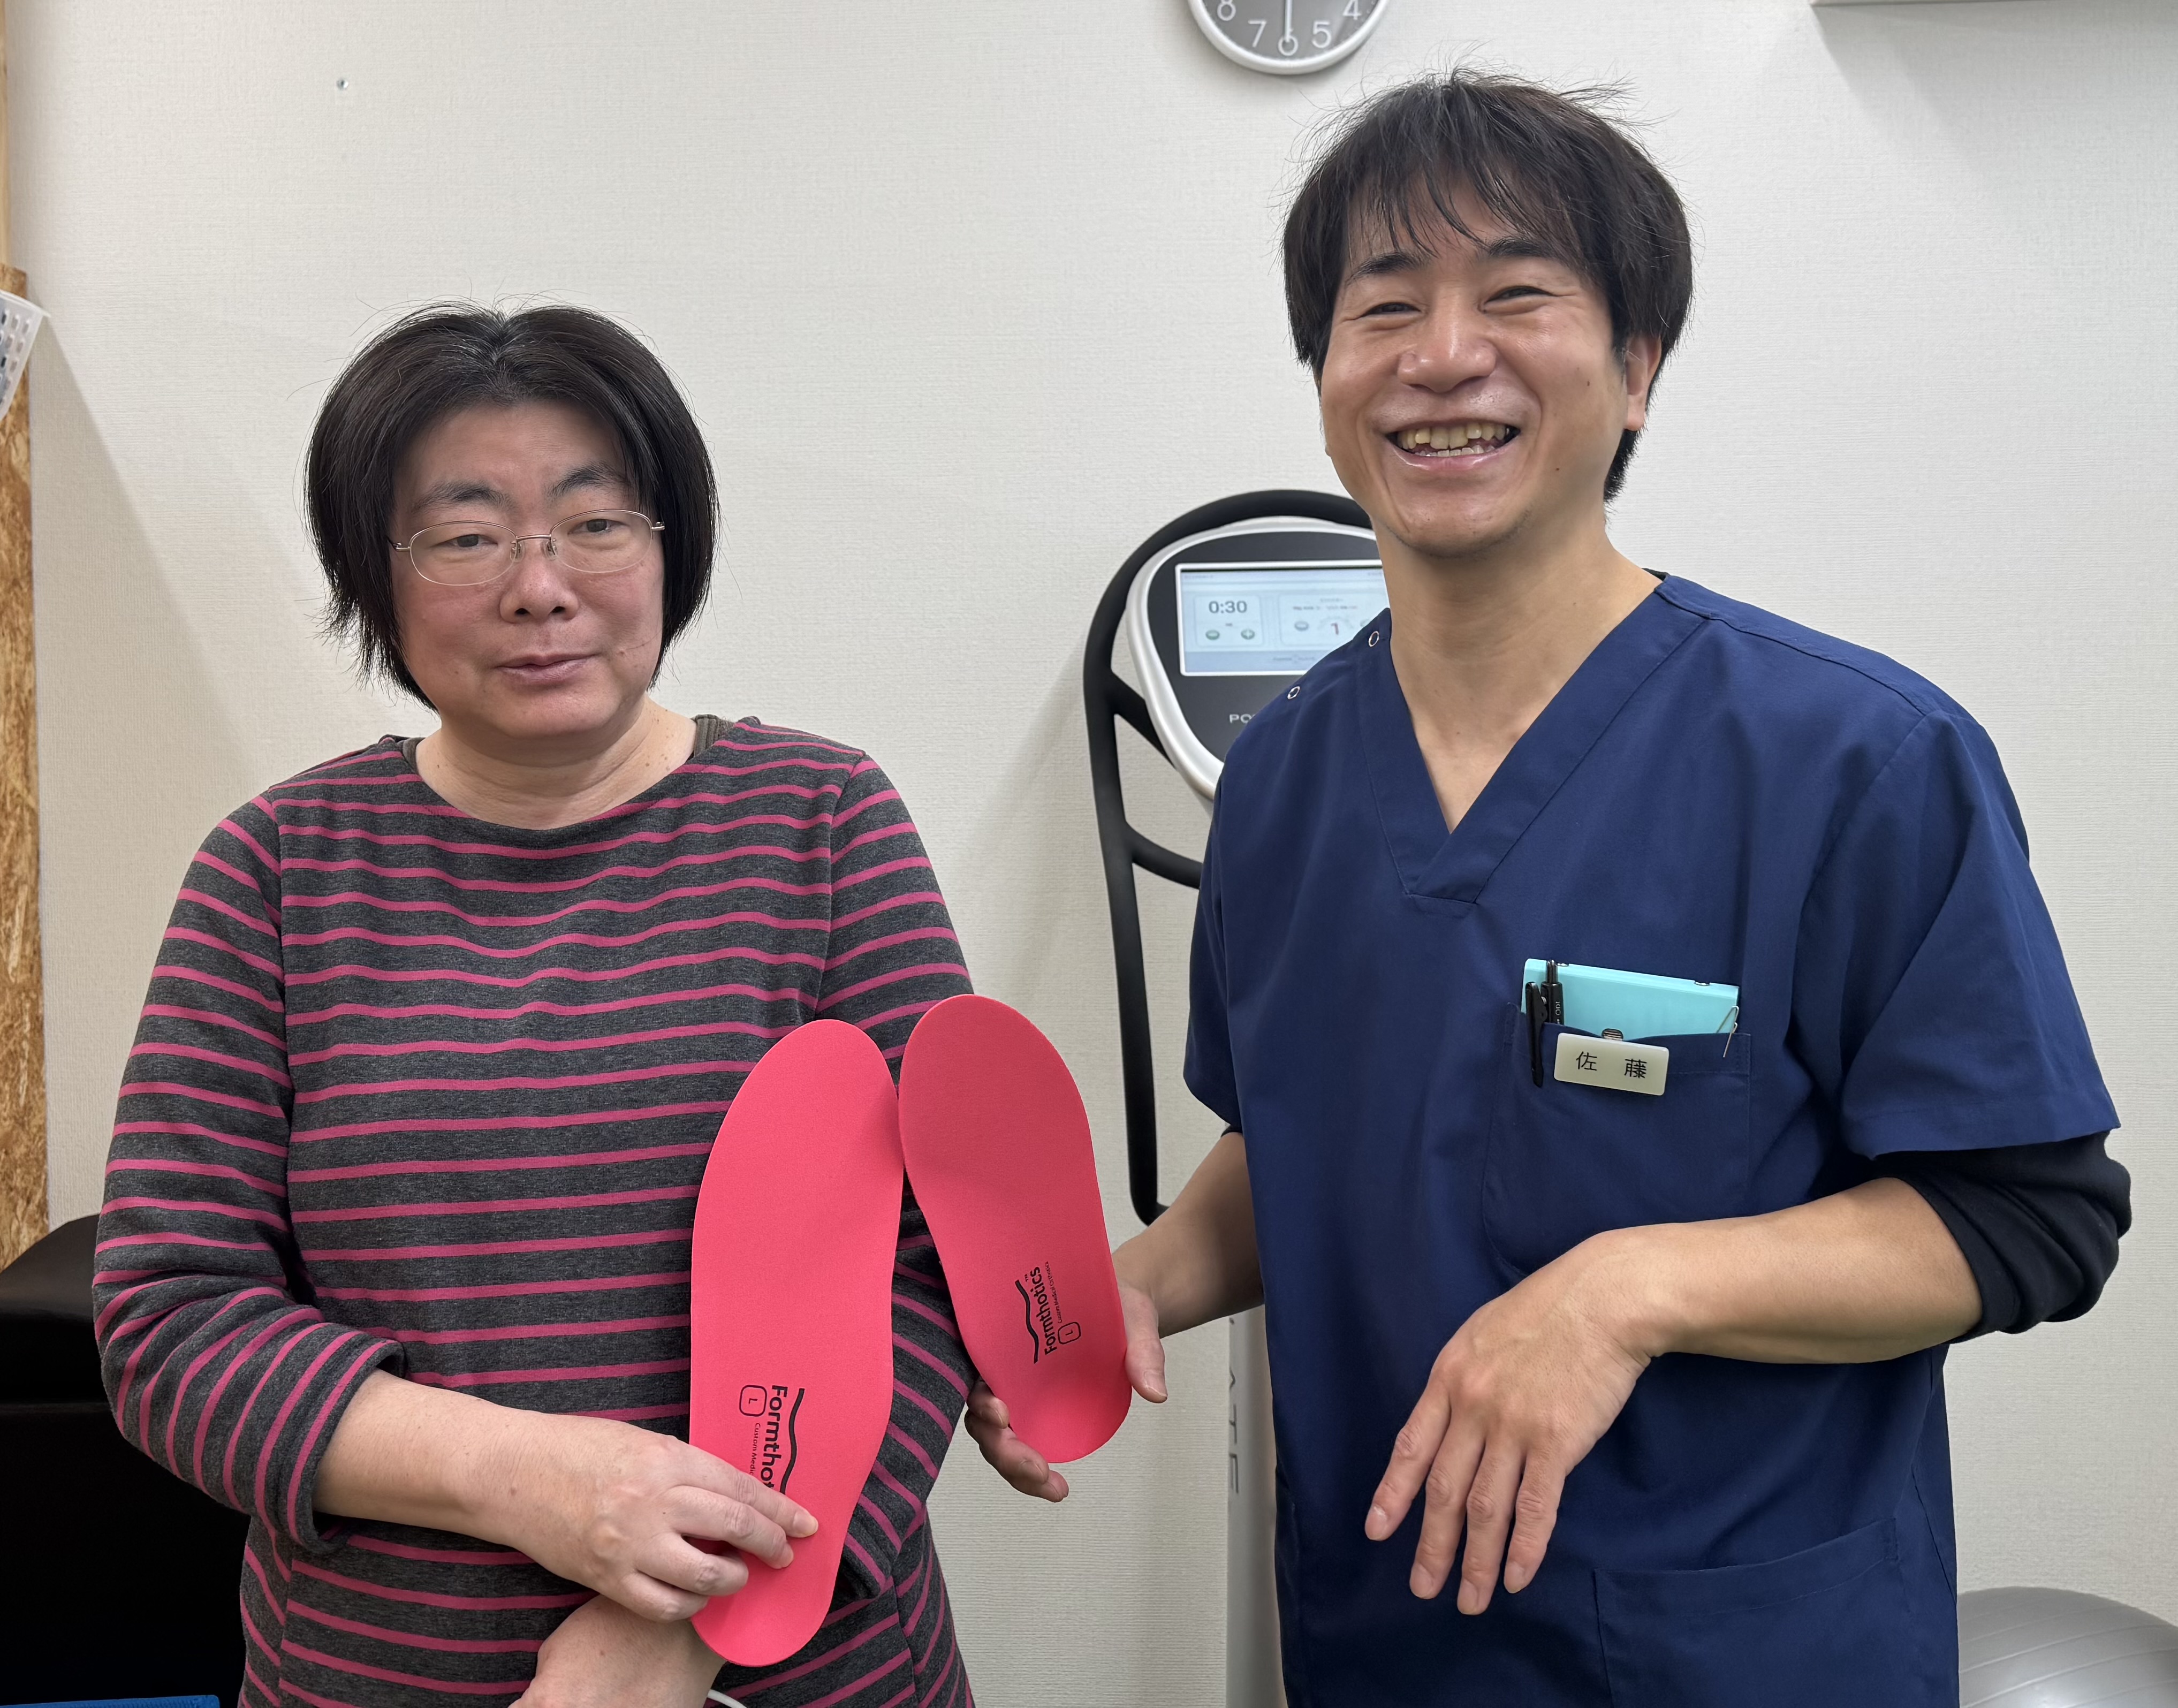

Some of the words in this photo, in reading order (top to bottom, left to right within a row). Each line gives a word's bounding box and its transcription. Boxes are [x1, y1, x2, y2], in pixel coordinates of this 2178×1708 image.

[1217, 0, 1236, 21] 8
[1342, 0, 1362, 20] 4
[1248, 19, 1267, 48] 7
[1311, 21, 1332, 49] 5
[1208, 600, 1248, 614] 0:30
[1229, 713, 1256, 724] PO
[1030, 1266, 1057, 1355] Formthotics
[752, 1423, 761, 1452] Custom
